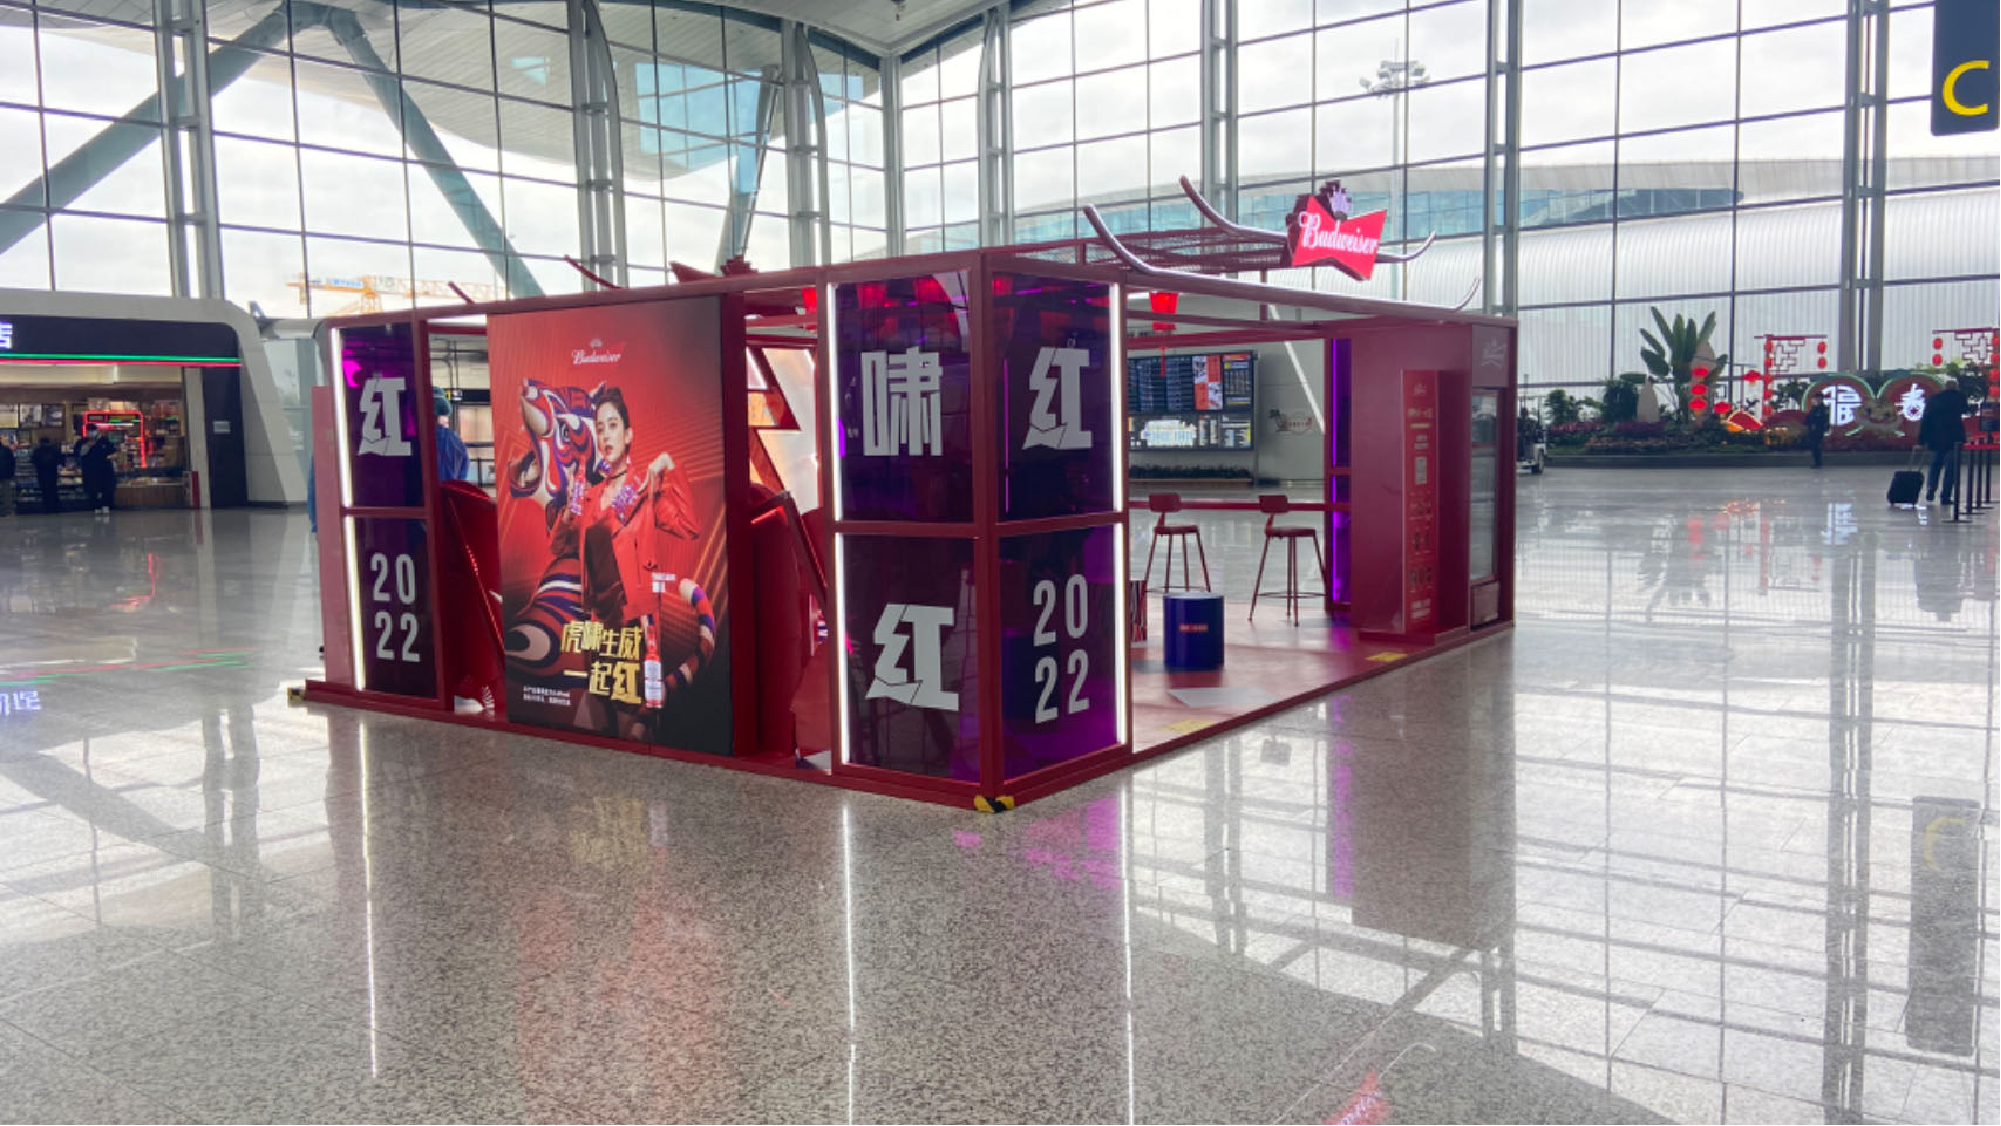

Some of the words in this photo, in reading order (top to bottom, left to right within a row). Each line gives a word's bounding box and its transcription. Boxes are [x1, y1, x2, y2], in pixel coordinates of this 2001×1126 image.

[1943, 60, 1989, 116] C
[1299, 211, 1380, 254] Budweiser
[358, 376, 411, 457] 红
[1022, 346, 1094, 450] 红
[370, 553, 416, 606] 20
[1033, 574, 1089, 647] 20
[374, 612, 421, 663] 22
[865, 603, 960, 711] 红
[563, 660, 642, 704] 一起红
[1034, 649, 1090, 724] 22
